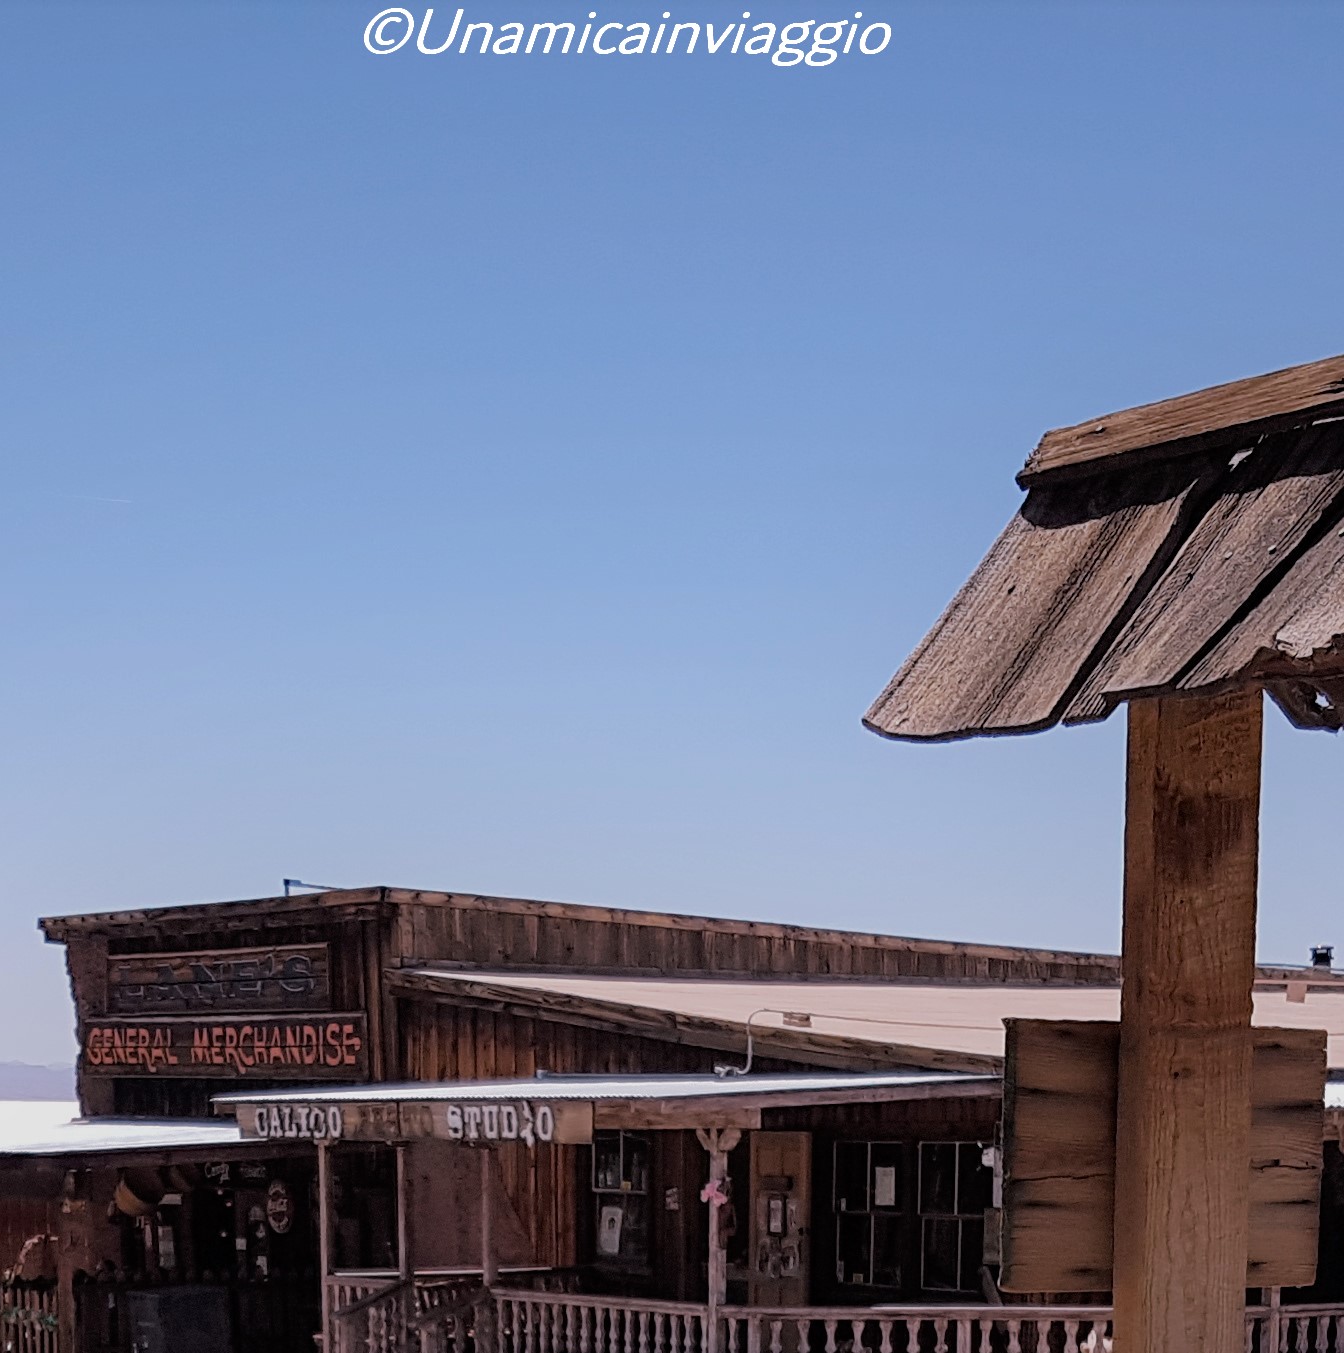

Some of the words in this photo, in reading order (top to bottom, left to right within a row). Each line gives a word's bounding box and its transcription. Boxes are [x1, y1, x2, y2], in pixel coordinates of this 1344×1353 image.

[87, 1027, 178, 1073] GENERAL
[190, 1022, 362, 1075] MERCHANDISE
[255, 1105, 342, 1139] CALICO
